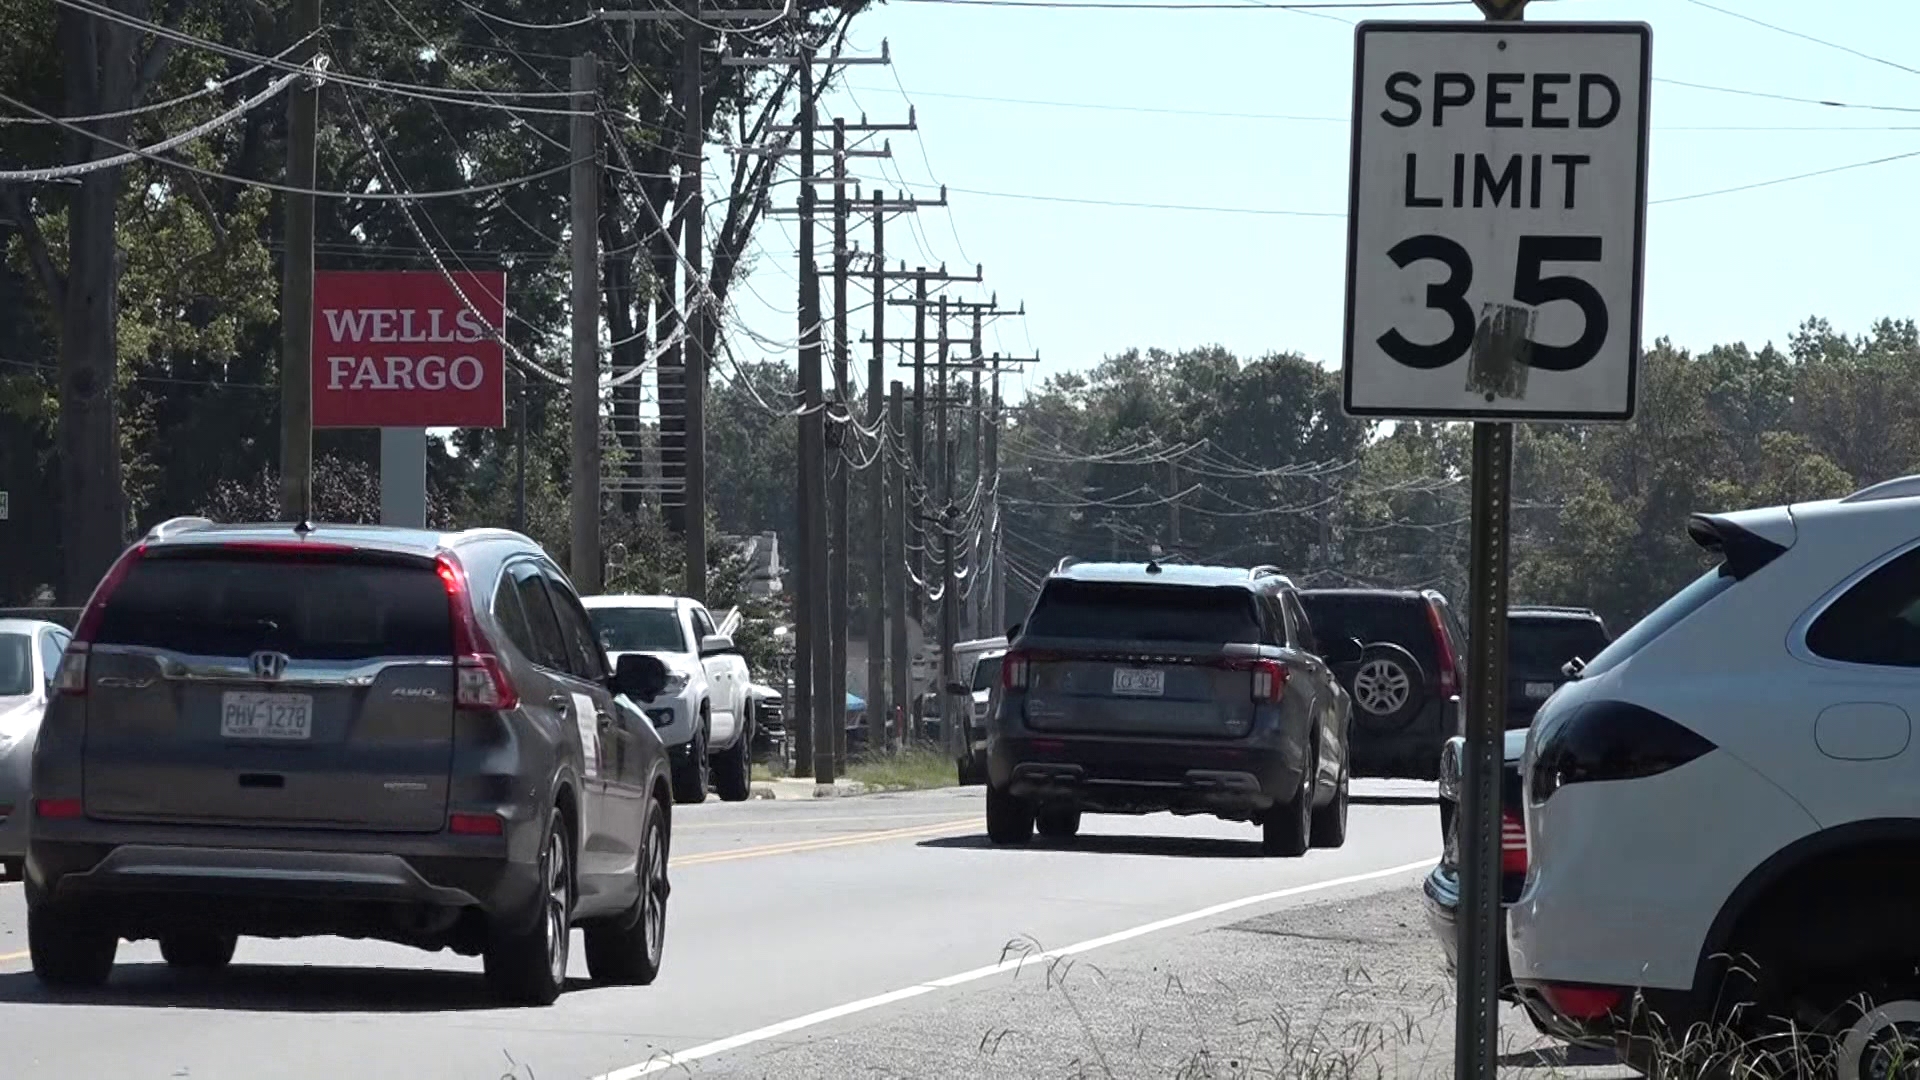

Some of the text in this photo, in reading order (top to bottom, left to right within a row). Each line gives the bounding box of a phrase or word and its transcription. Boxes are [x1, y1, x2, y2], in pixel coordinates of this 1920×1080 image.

[1380, 71, 1621, 128] SPEED
[1404, 153, 1591, 209] LIMIT
[322, 308, 484, 343] WELLS
[1375, 234, 1609, 372] 35
[326, 355, 484, 391] FARGO
